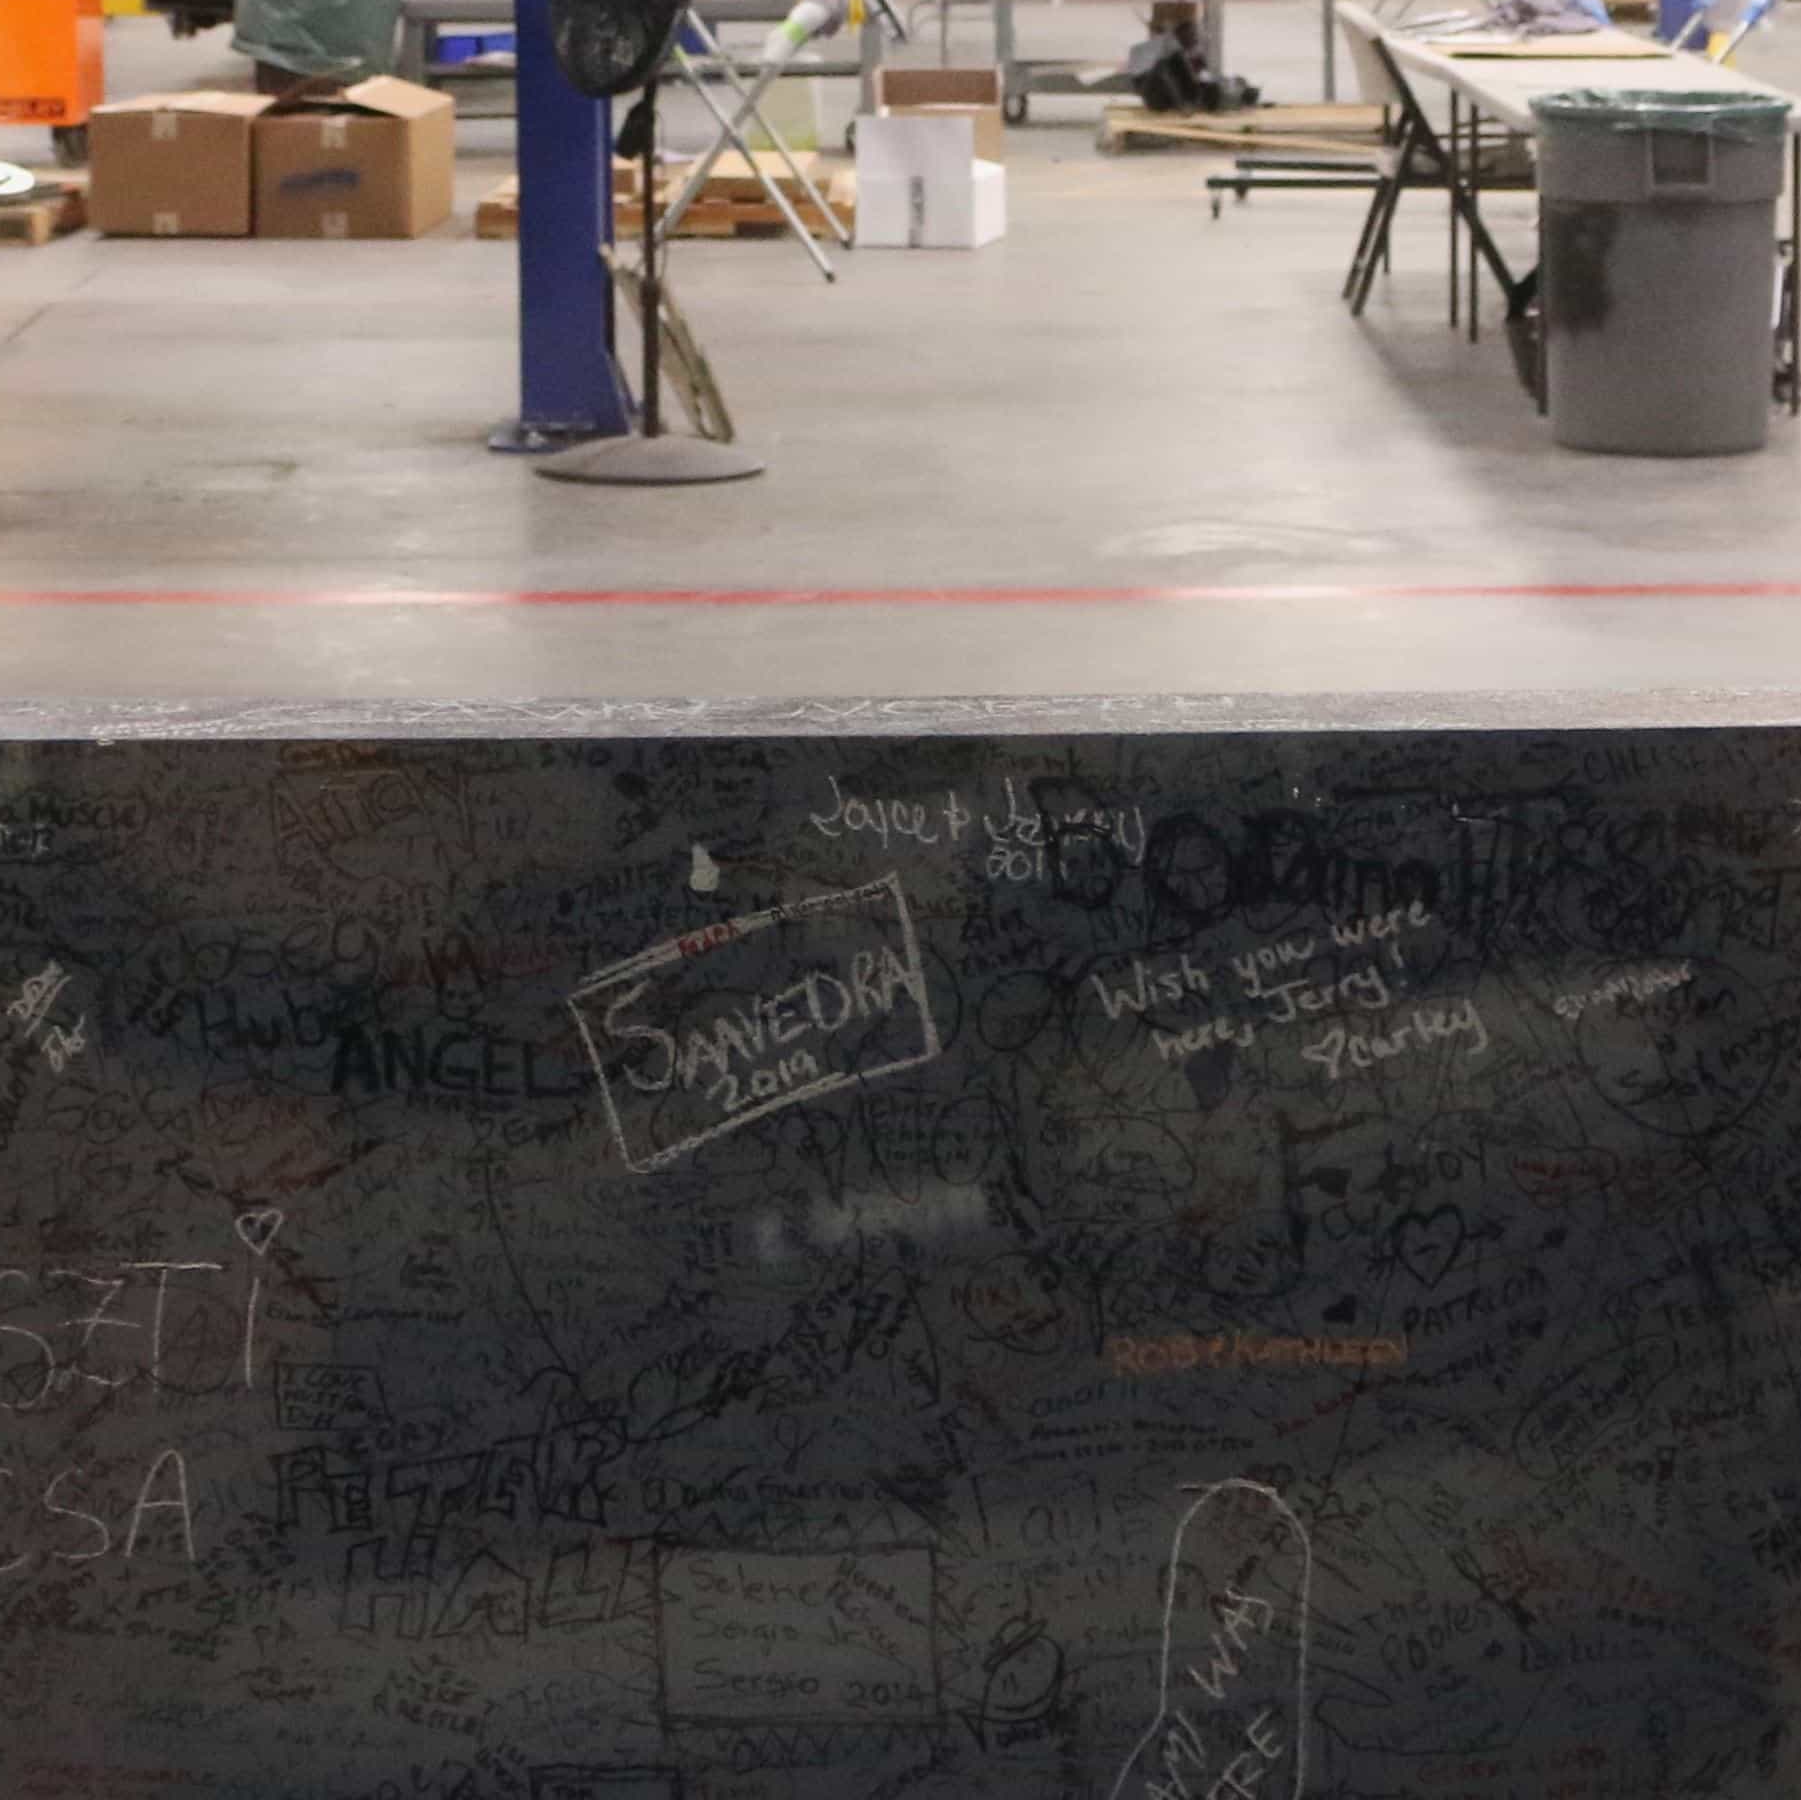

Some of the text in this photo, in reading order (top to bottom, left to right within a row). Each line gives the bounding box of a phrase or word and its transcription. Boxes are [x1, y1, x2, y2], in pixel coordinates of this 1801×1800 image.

[810, 776, 941, 852] Joyce
[1090, 898, 1434, 1022] Wish you were
[332, 1022, 567, 1098] ANGEL
